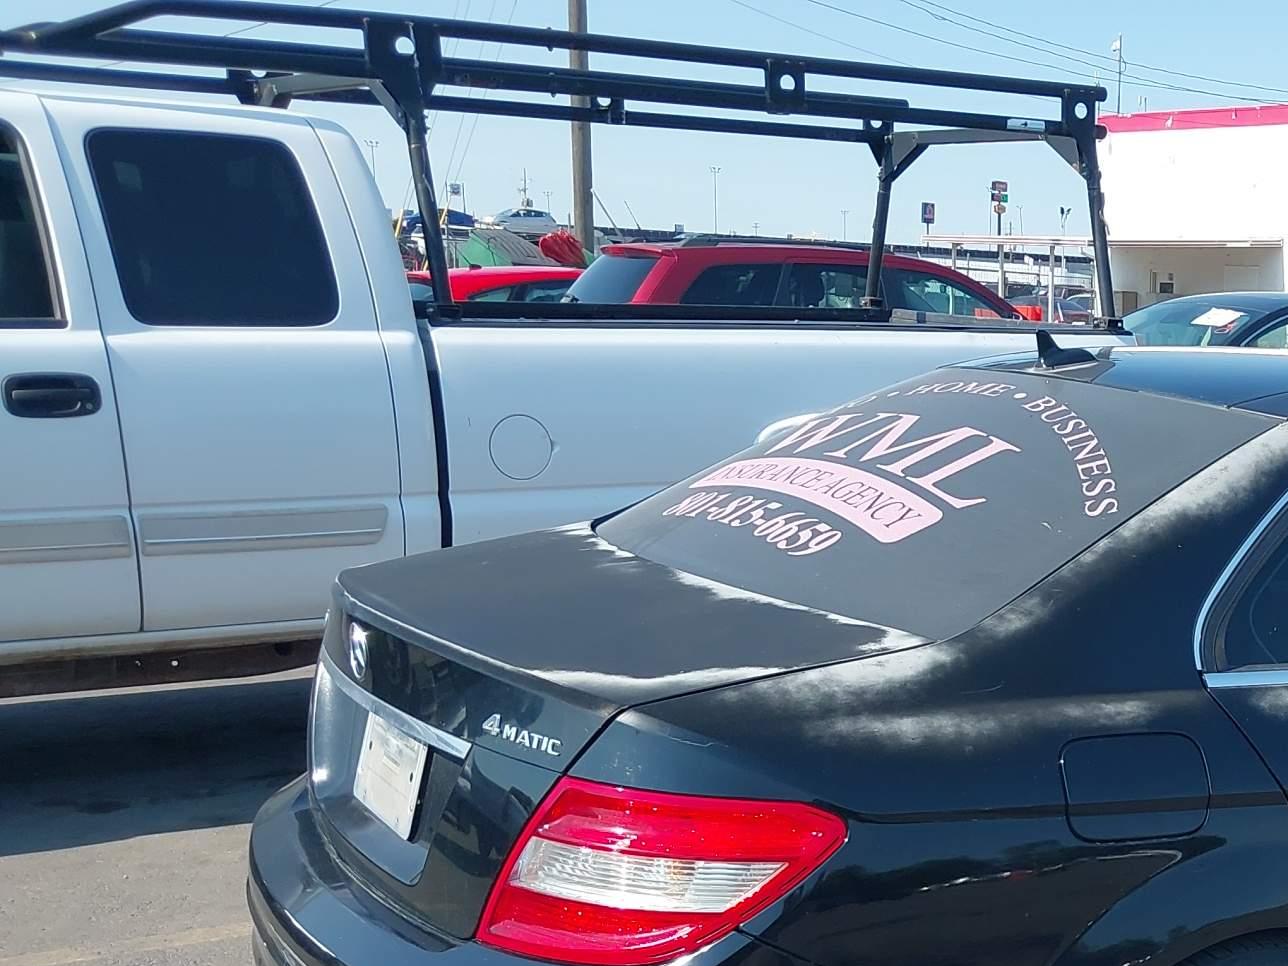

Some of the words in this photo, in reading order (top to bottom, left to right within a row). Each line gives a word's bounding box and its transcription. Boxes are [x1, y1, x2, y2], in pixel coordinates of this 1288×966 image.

[763, 412, 1023, 509] WML
[904, 381, 1017, 397] HOME
[1020, 395, 1120, 518] BUSINESS
[661, 490, 843, 557] 801-815-6659
[707, 462, 825, 492] INSURANCE
[816, 476, 925, 529] AGENCY
